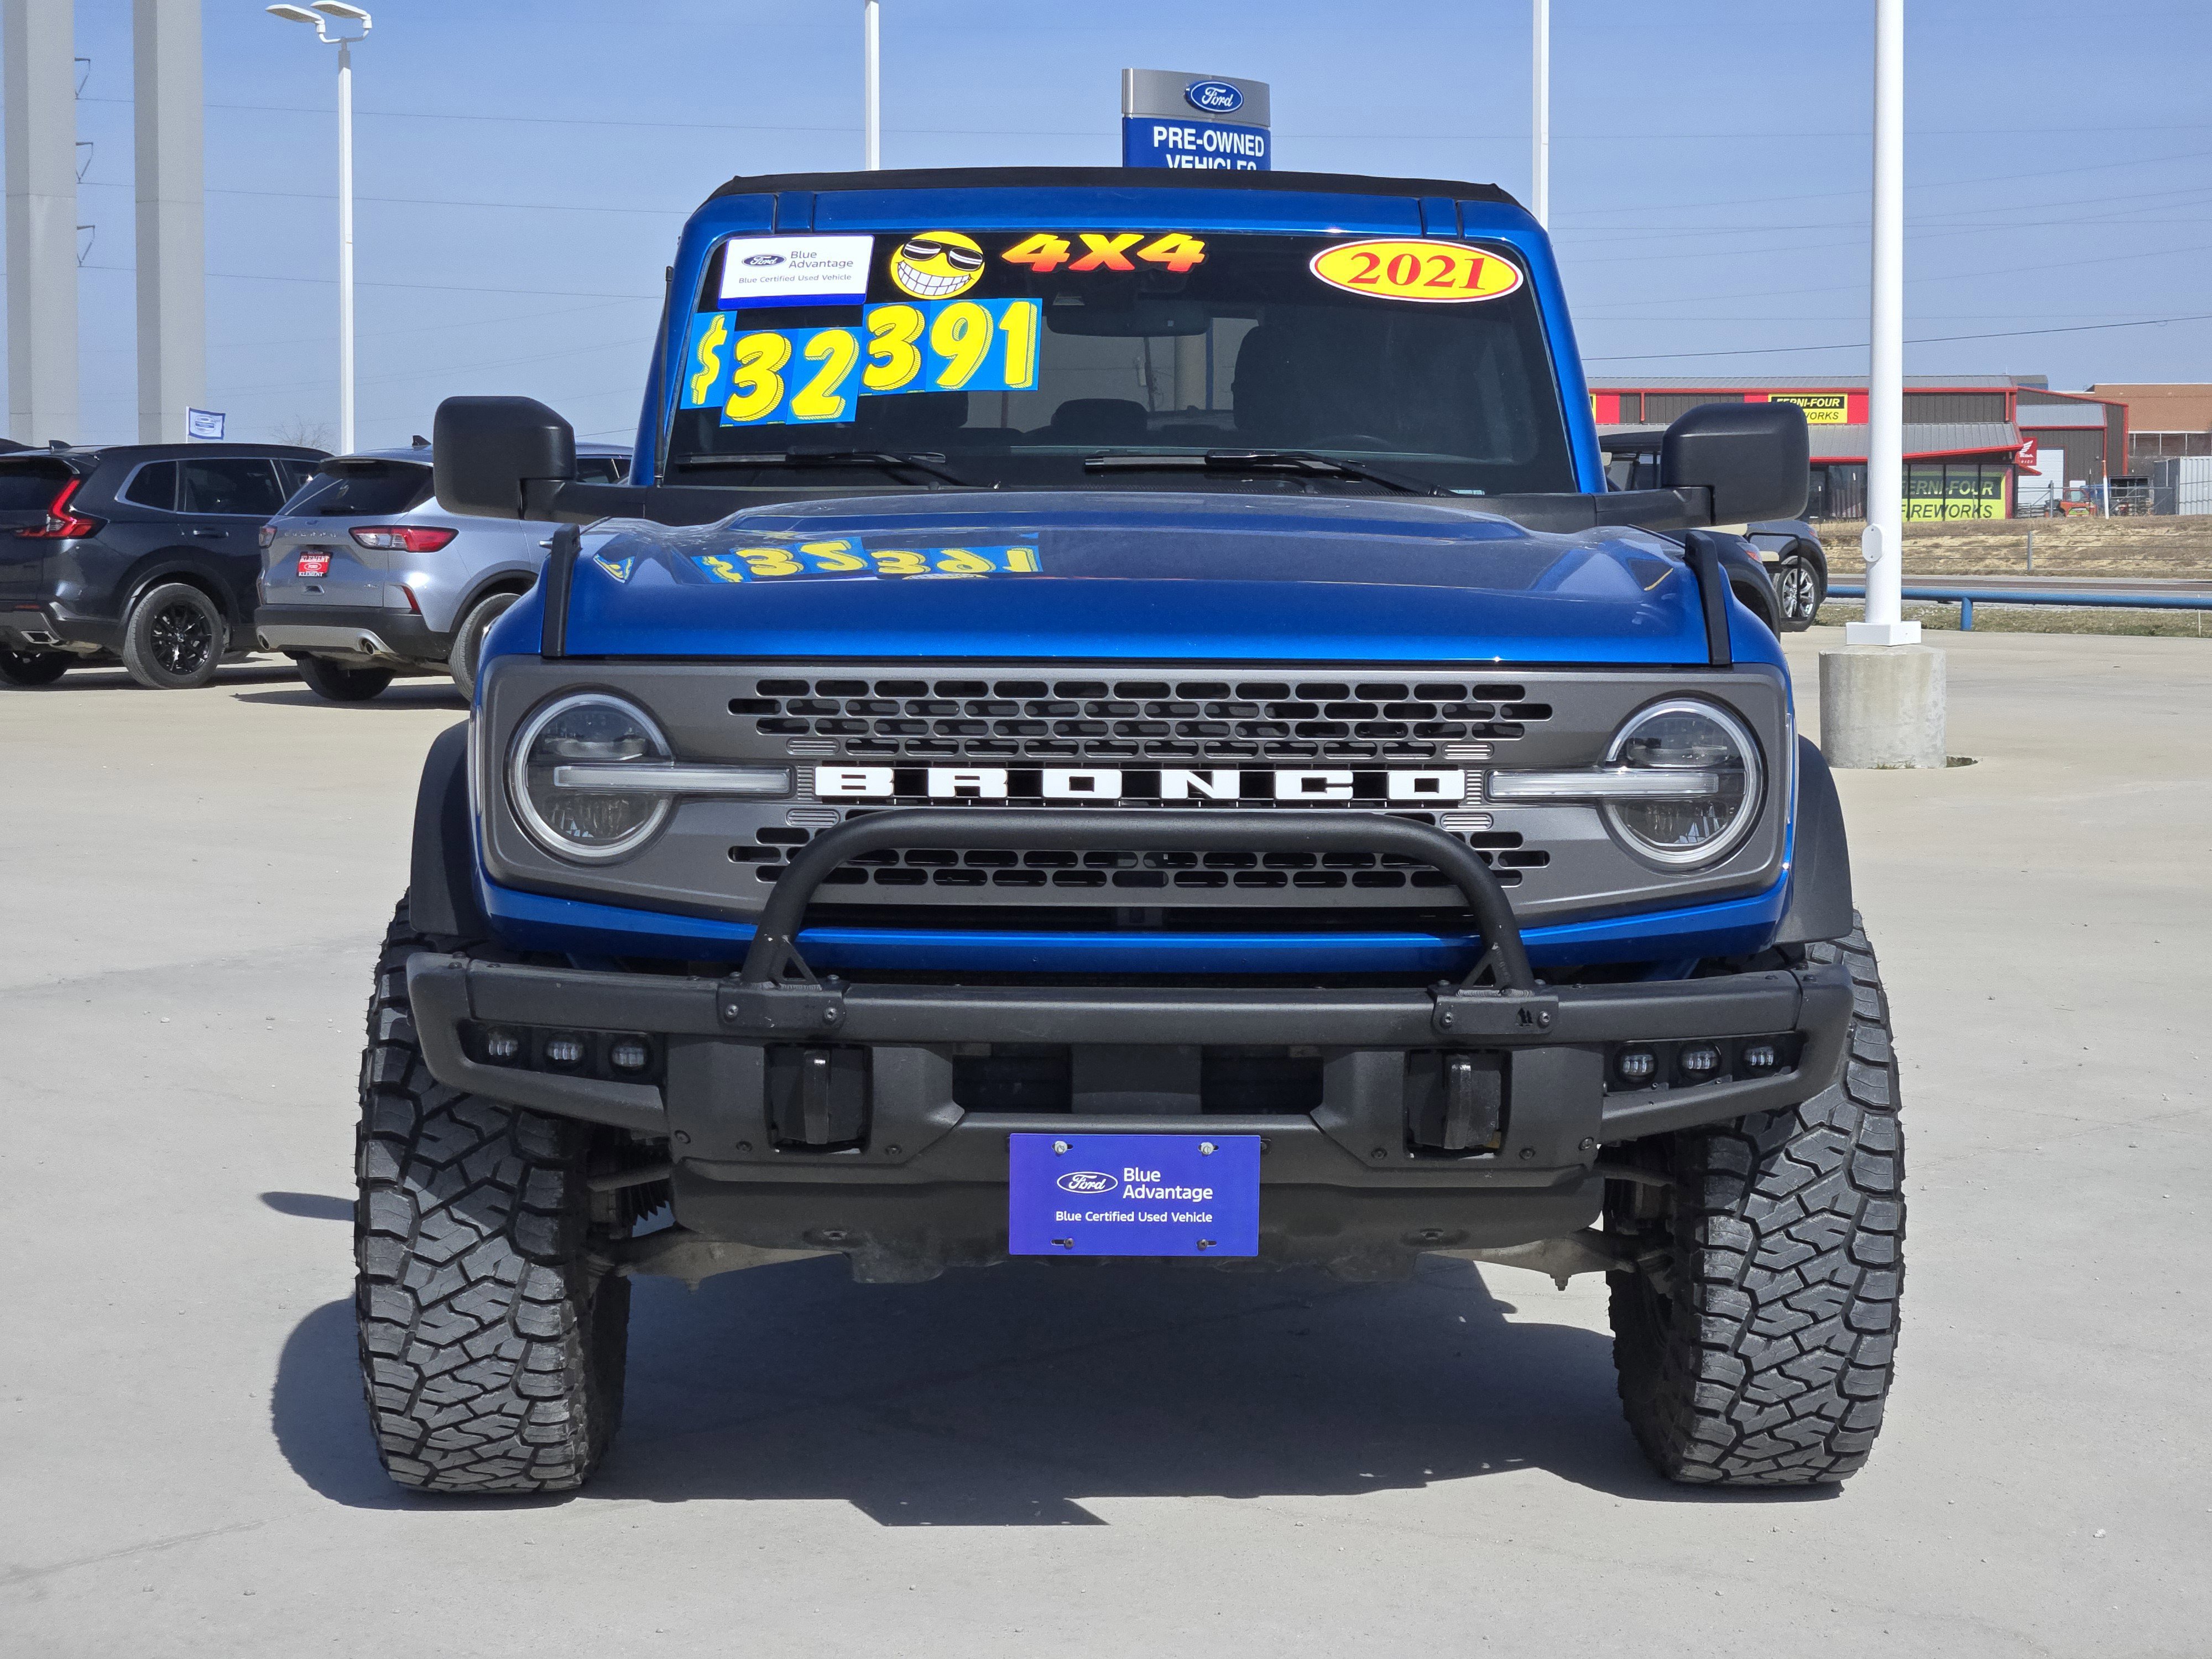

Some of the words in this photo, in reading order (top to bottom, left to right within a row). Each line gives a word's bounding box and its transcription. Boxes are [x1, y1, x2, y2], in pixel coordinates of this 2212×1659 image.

[1201, 86, 1234, 107] Ford
[1154, 126, 1264, 157] PRE-OWNED
[791, 251, 817, 259] Blue
[1001, 233, 1206, 272] 4X4
[789, 260, 854, 269] Advantage
[1348, 252, 1486, 290] 2021
[815, 766, 1465, 800] BRONCO
[1068, 1173, 1107, 1191] Ford
[1123, 1167, 1161, 1182] Blue
[1123, 1185, 1213, 1202] Advantage
[1055, 1211, 1082, 1222] Blue
[1085, 1211, 1134, 1222] Certified
[1138, 1212, 1167, 1222] Used
[1171, 1212, 1213, 1223] Vehicle
